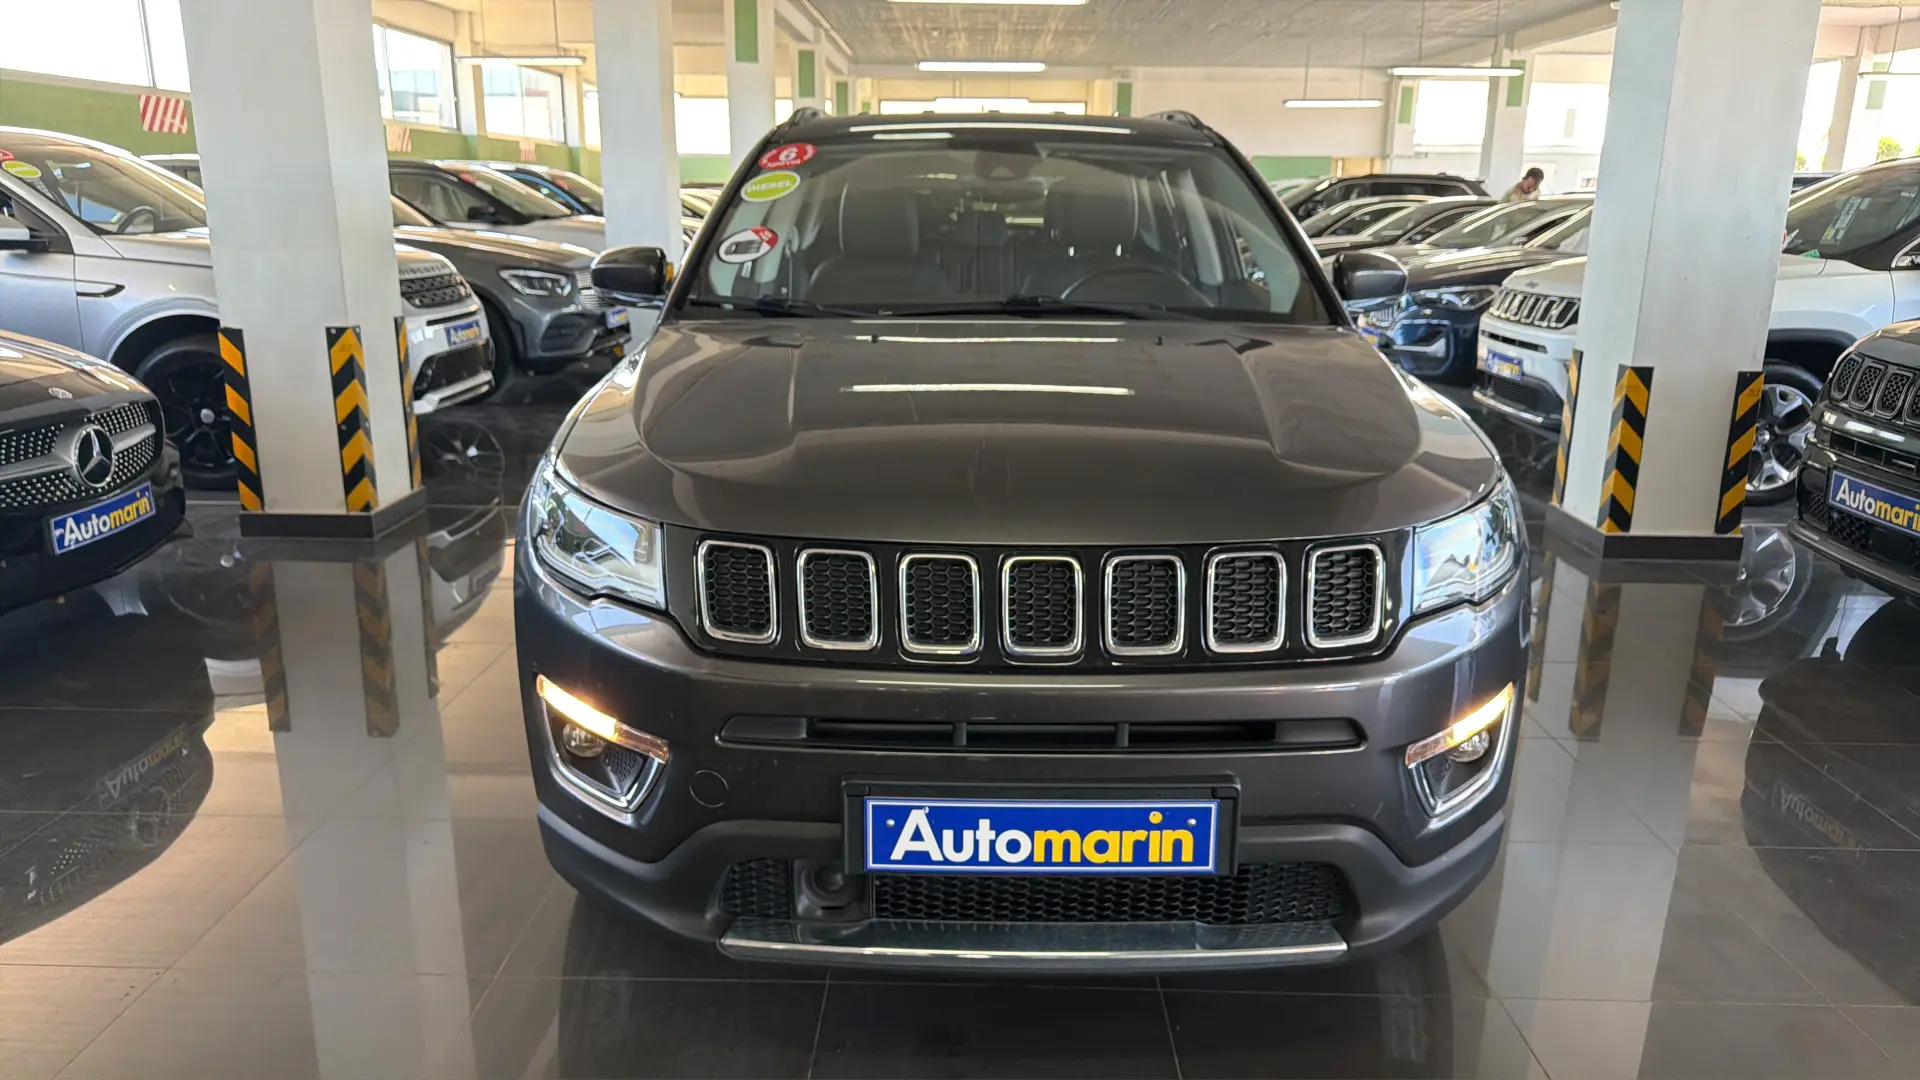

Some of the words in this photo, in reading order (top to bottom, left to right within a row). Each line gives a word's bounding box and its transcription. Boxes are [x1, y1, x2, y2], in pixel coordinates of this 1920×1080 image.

[63, 491, 151, 547] Automarin
[1835, 478, 1920, 532] Automari
[890, 808, 1194, 863] Automarin
